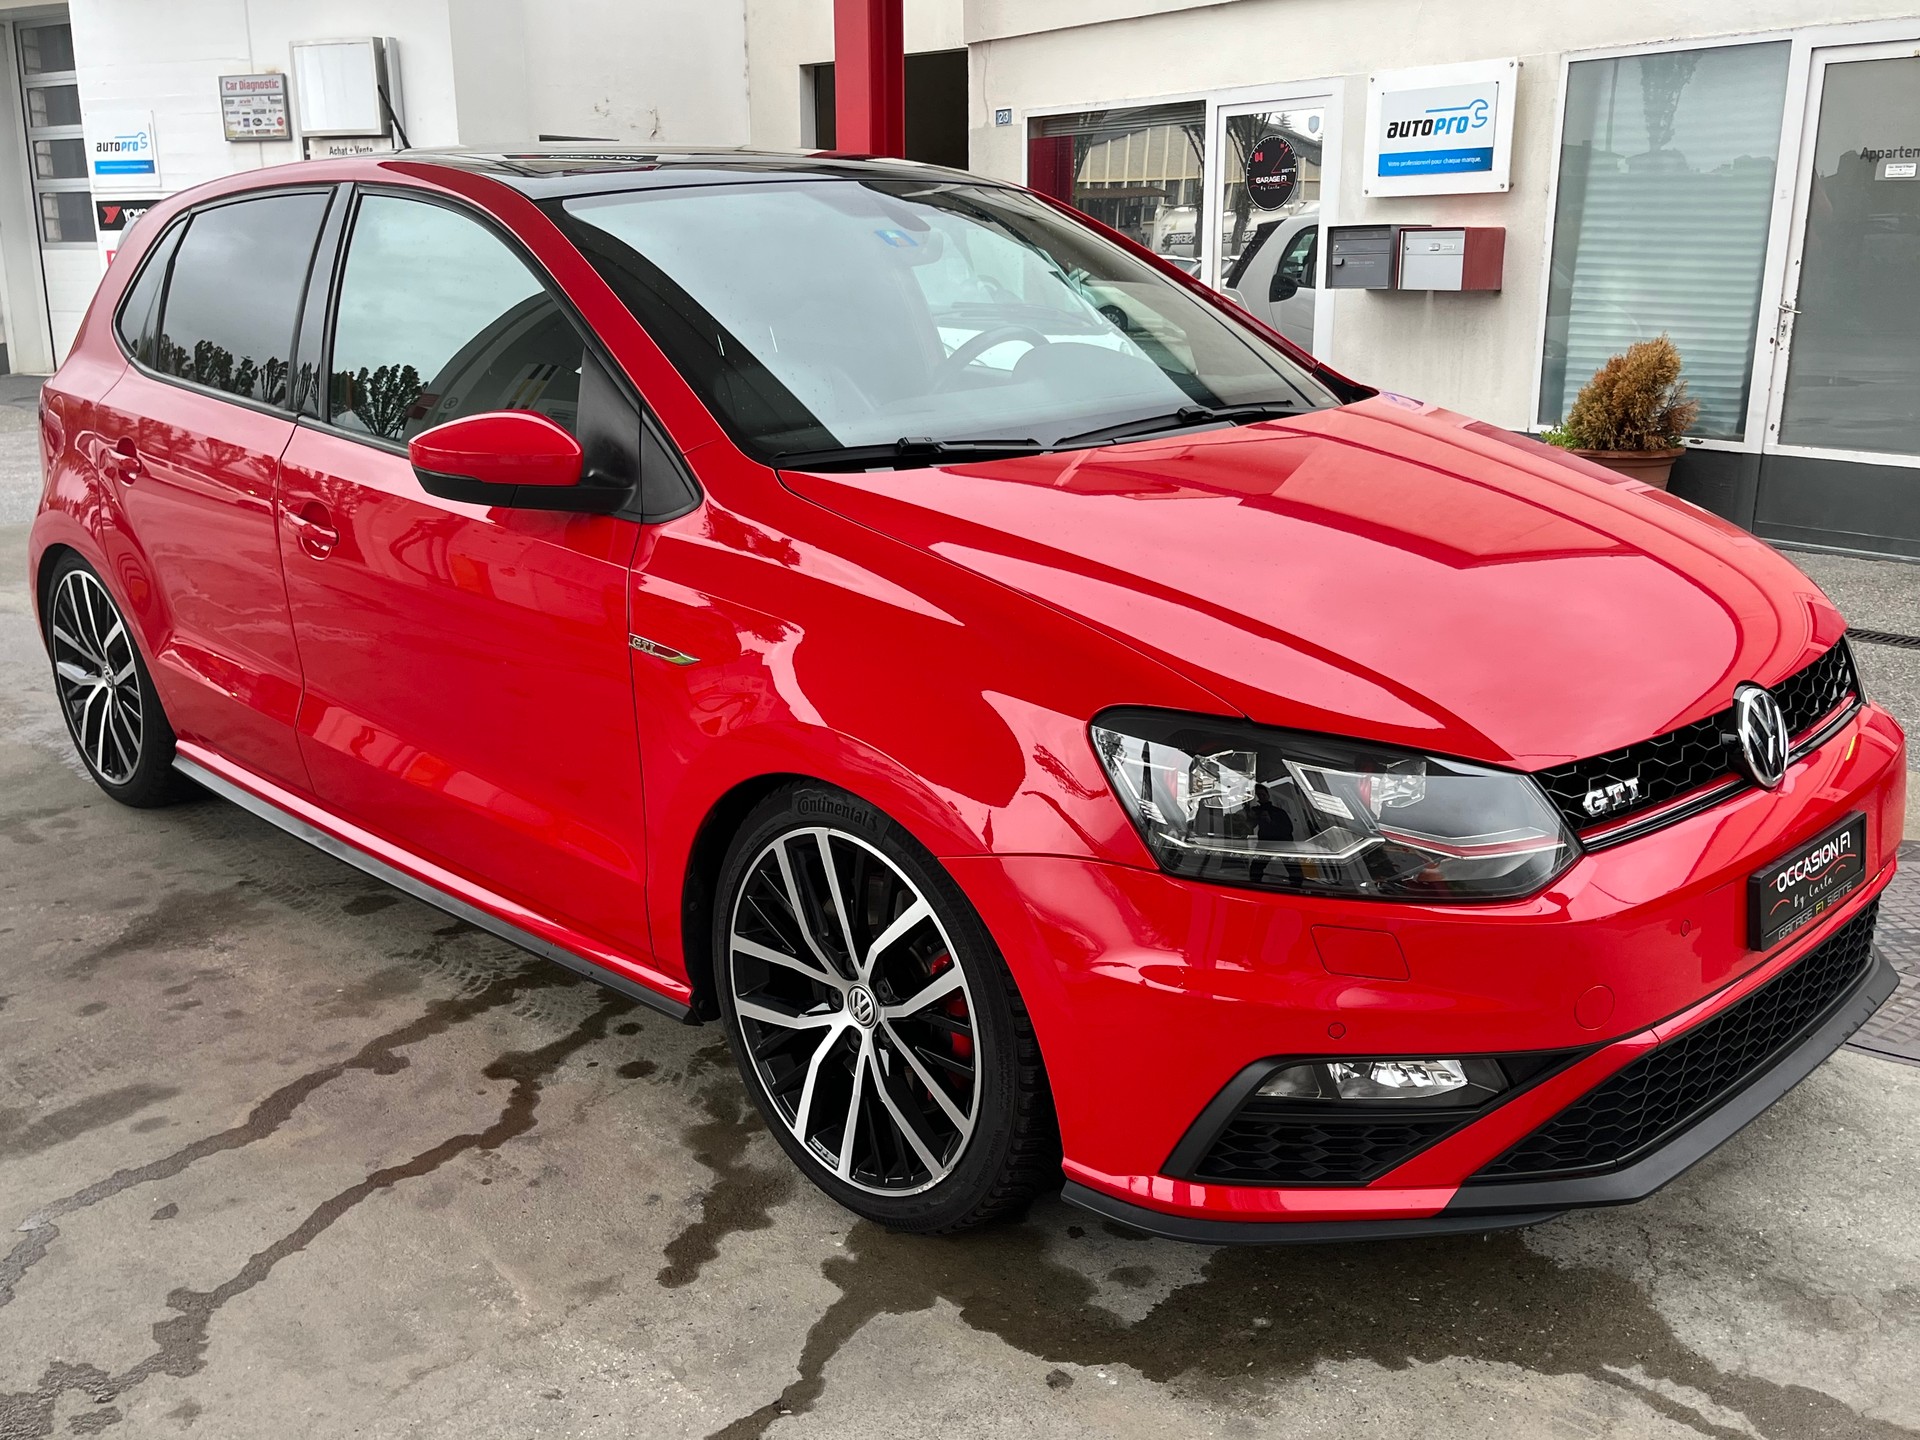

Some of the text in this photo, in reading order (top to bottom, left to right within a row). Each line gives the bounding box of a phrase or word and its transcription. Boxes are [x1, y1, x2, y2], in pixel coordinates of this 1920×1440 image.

[225, 79, 279, 92] Car Diagnostic
[329, 145, 348, 156] Achat
[1443, 157, 1460, 165] chaque
[1255, 175, 1281, 184] GARAGE
[632, 637, 656, 655] GTI
[1583, 778, 1643, 817] GTI
[797, 796, 870, 827] Continental
[1777, 838, 1839, 893] OCCASION
